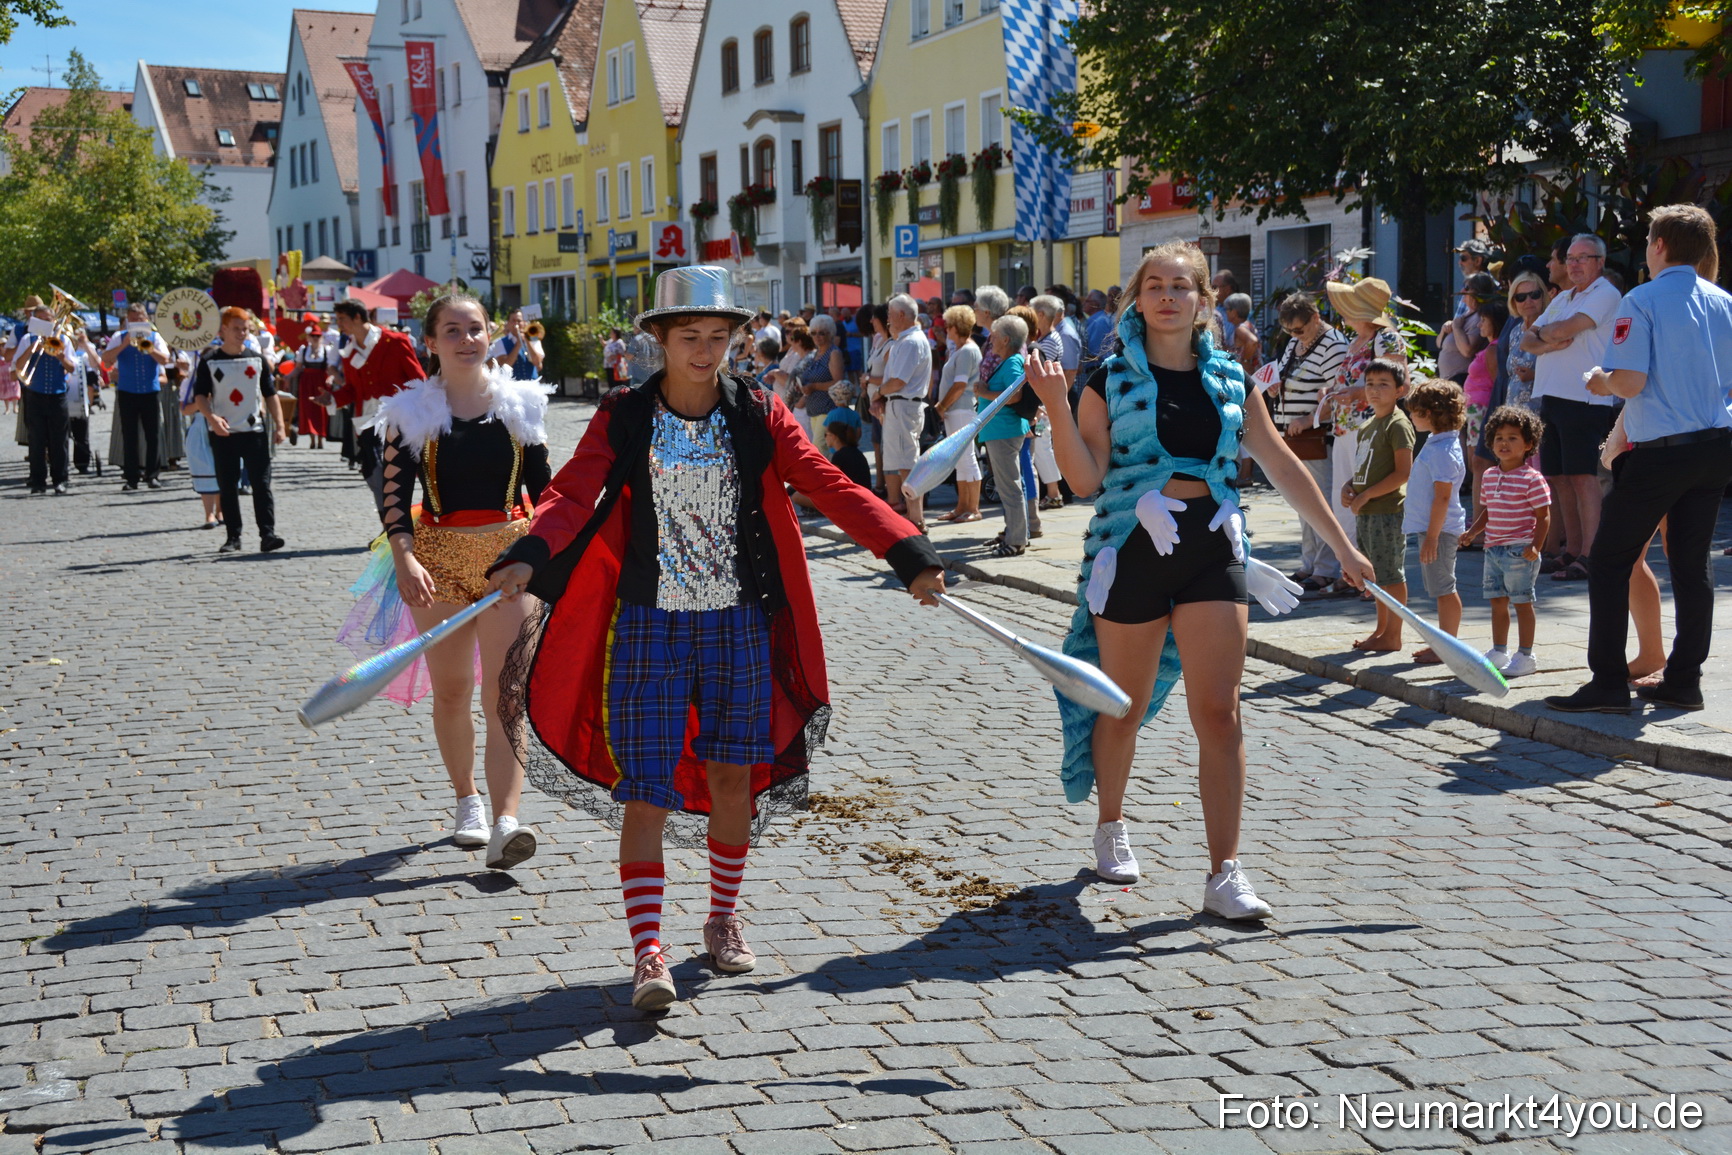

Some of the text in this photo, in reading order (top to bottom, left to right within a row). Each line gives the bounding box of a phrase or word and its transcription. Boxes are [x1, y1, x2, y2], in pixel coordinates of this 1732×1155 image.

[411, 47, 428, 89] K&L
[530, 153, 553, 176] HOTEL
[1106, 171, 1115, 232] KINO
[900, 228, 914, 254] P
[532, 255, 562, 270] Restaurant
[157, 289, 215, 319] BLASKAPELLE
[171, 330, 213, 350] DEINING
